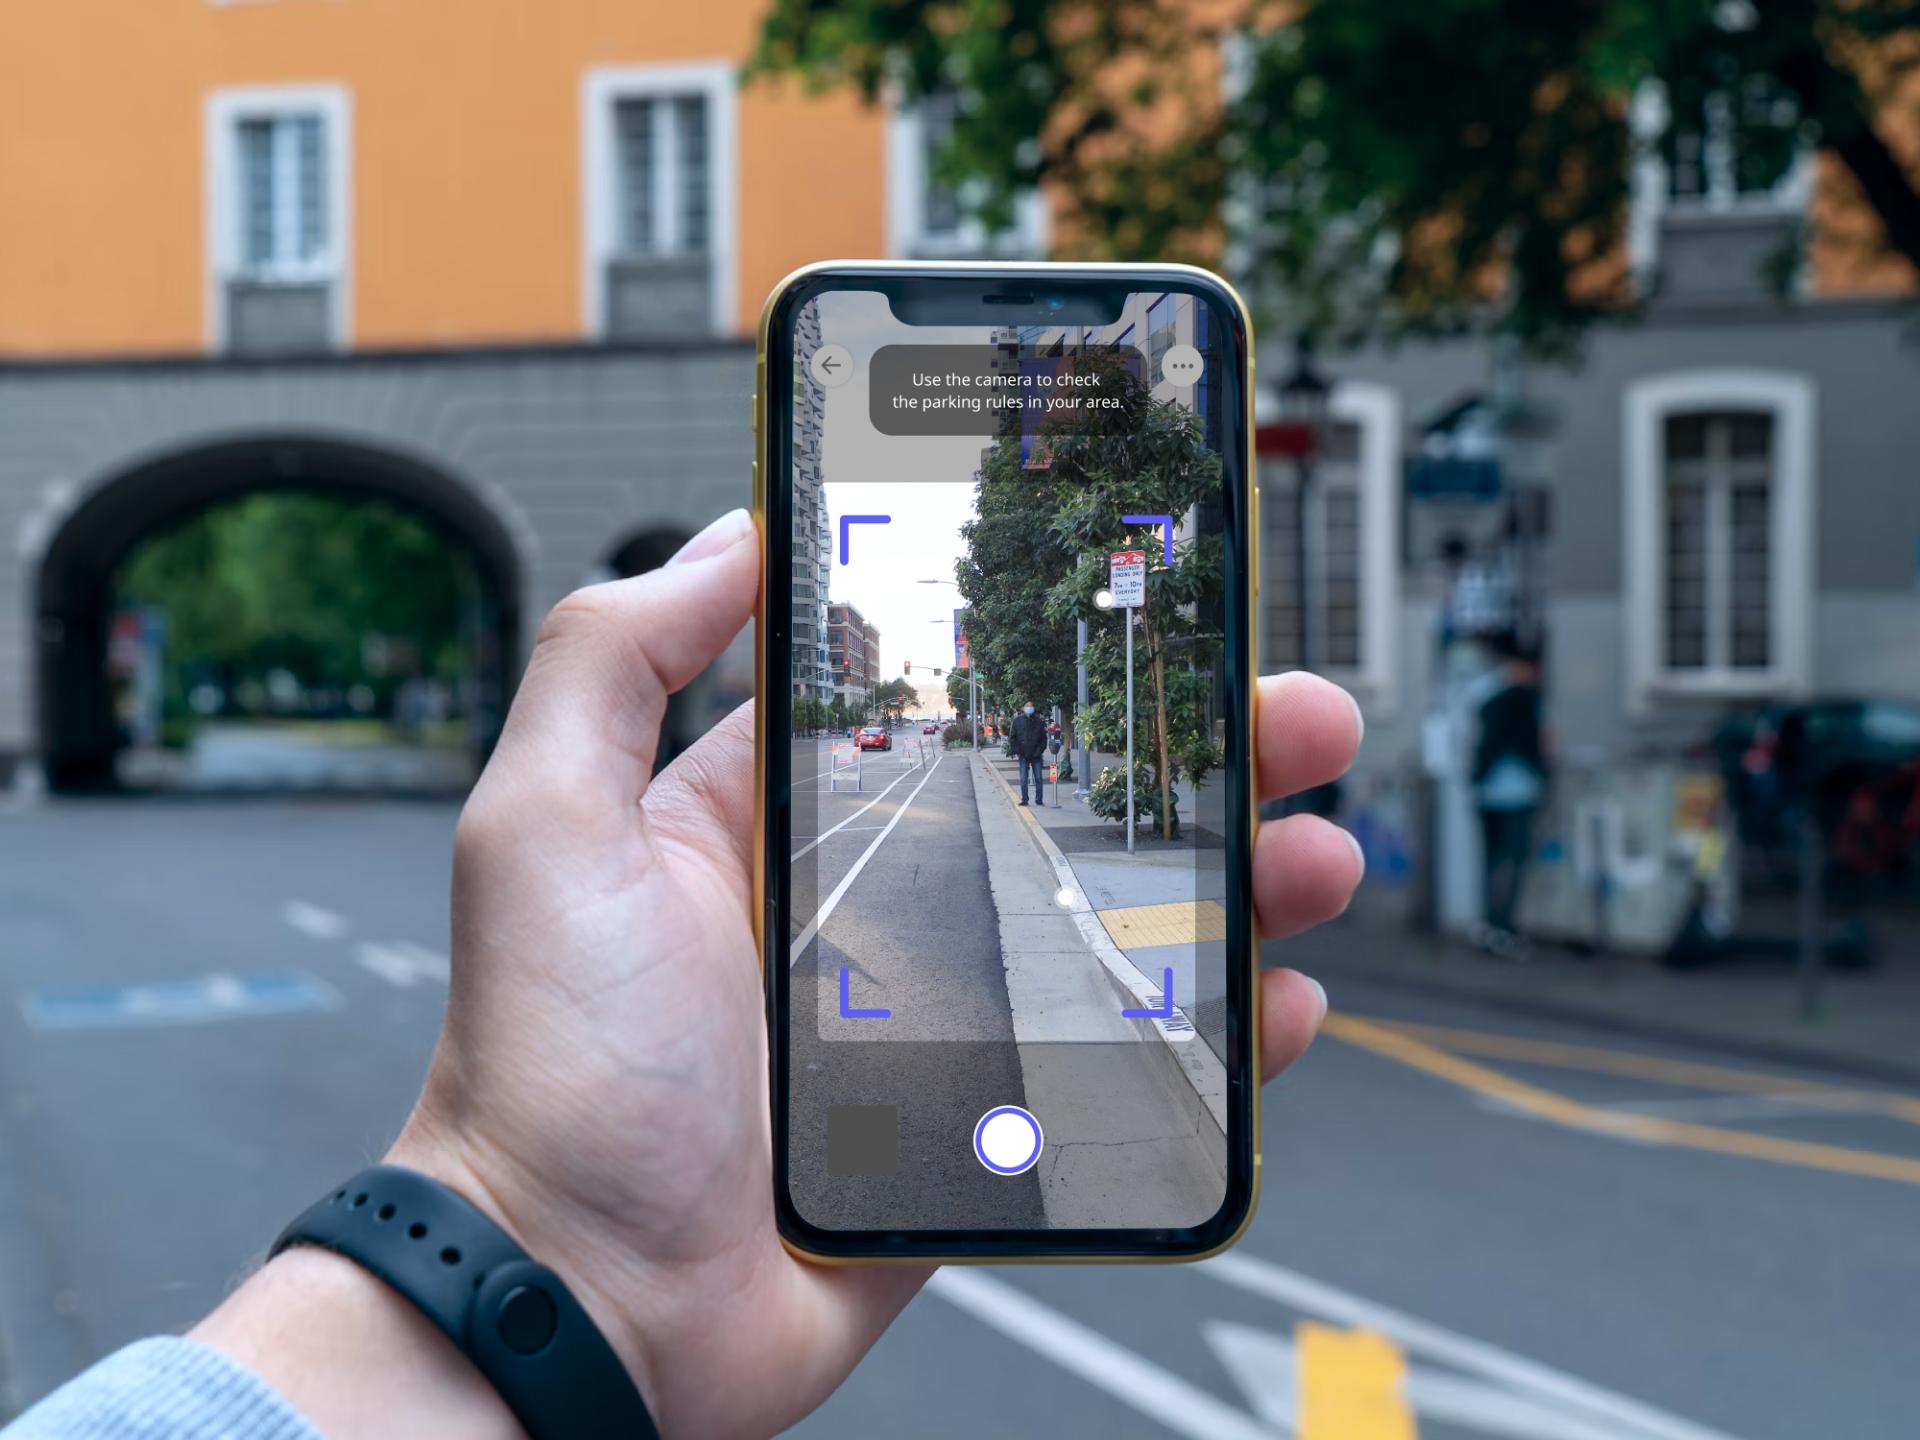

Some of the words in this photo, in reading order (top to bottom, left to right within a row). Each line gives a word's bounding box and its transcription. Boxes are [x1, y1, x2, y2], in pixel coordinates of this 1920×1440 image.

[912, 372, 942, 387] Use
[946, 372, 971, 387] the
[975, 375, 1032, 387] camera
[1036, 373, 1052, 387] to
[1056, 372, 1101, 387] check
[892, 394, 918, 409] the
[922, 394, 981, 413] parking
[986, 394, 1024, 409] rules
[1028, 394, 1042, 409] in
[1046, 397, 1082, 413] your
[1086, 397, 1125, 409] area.
